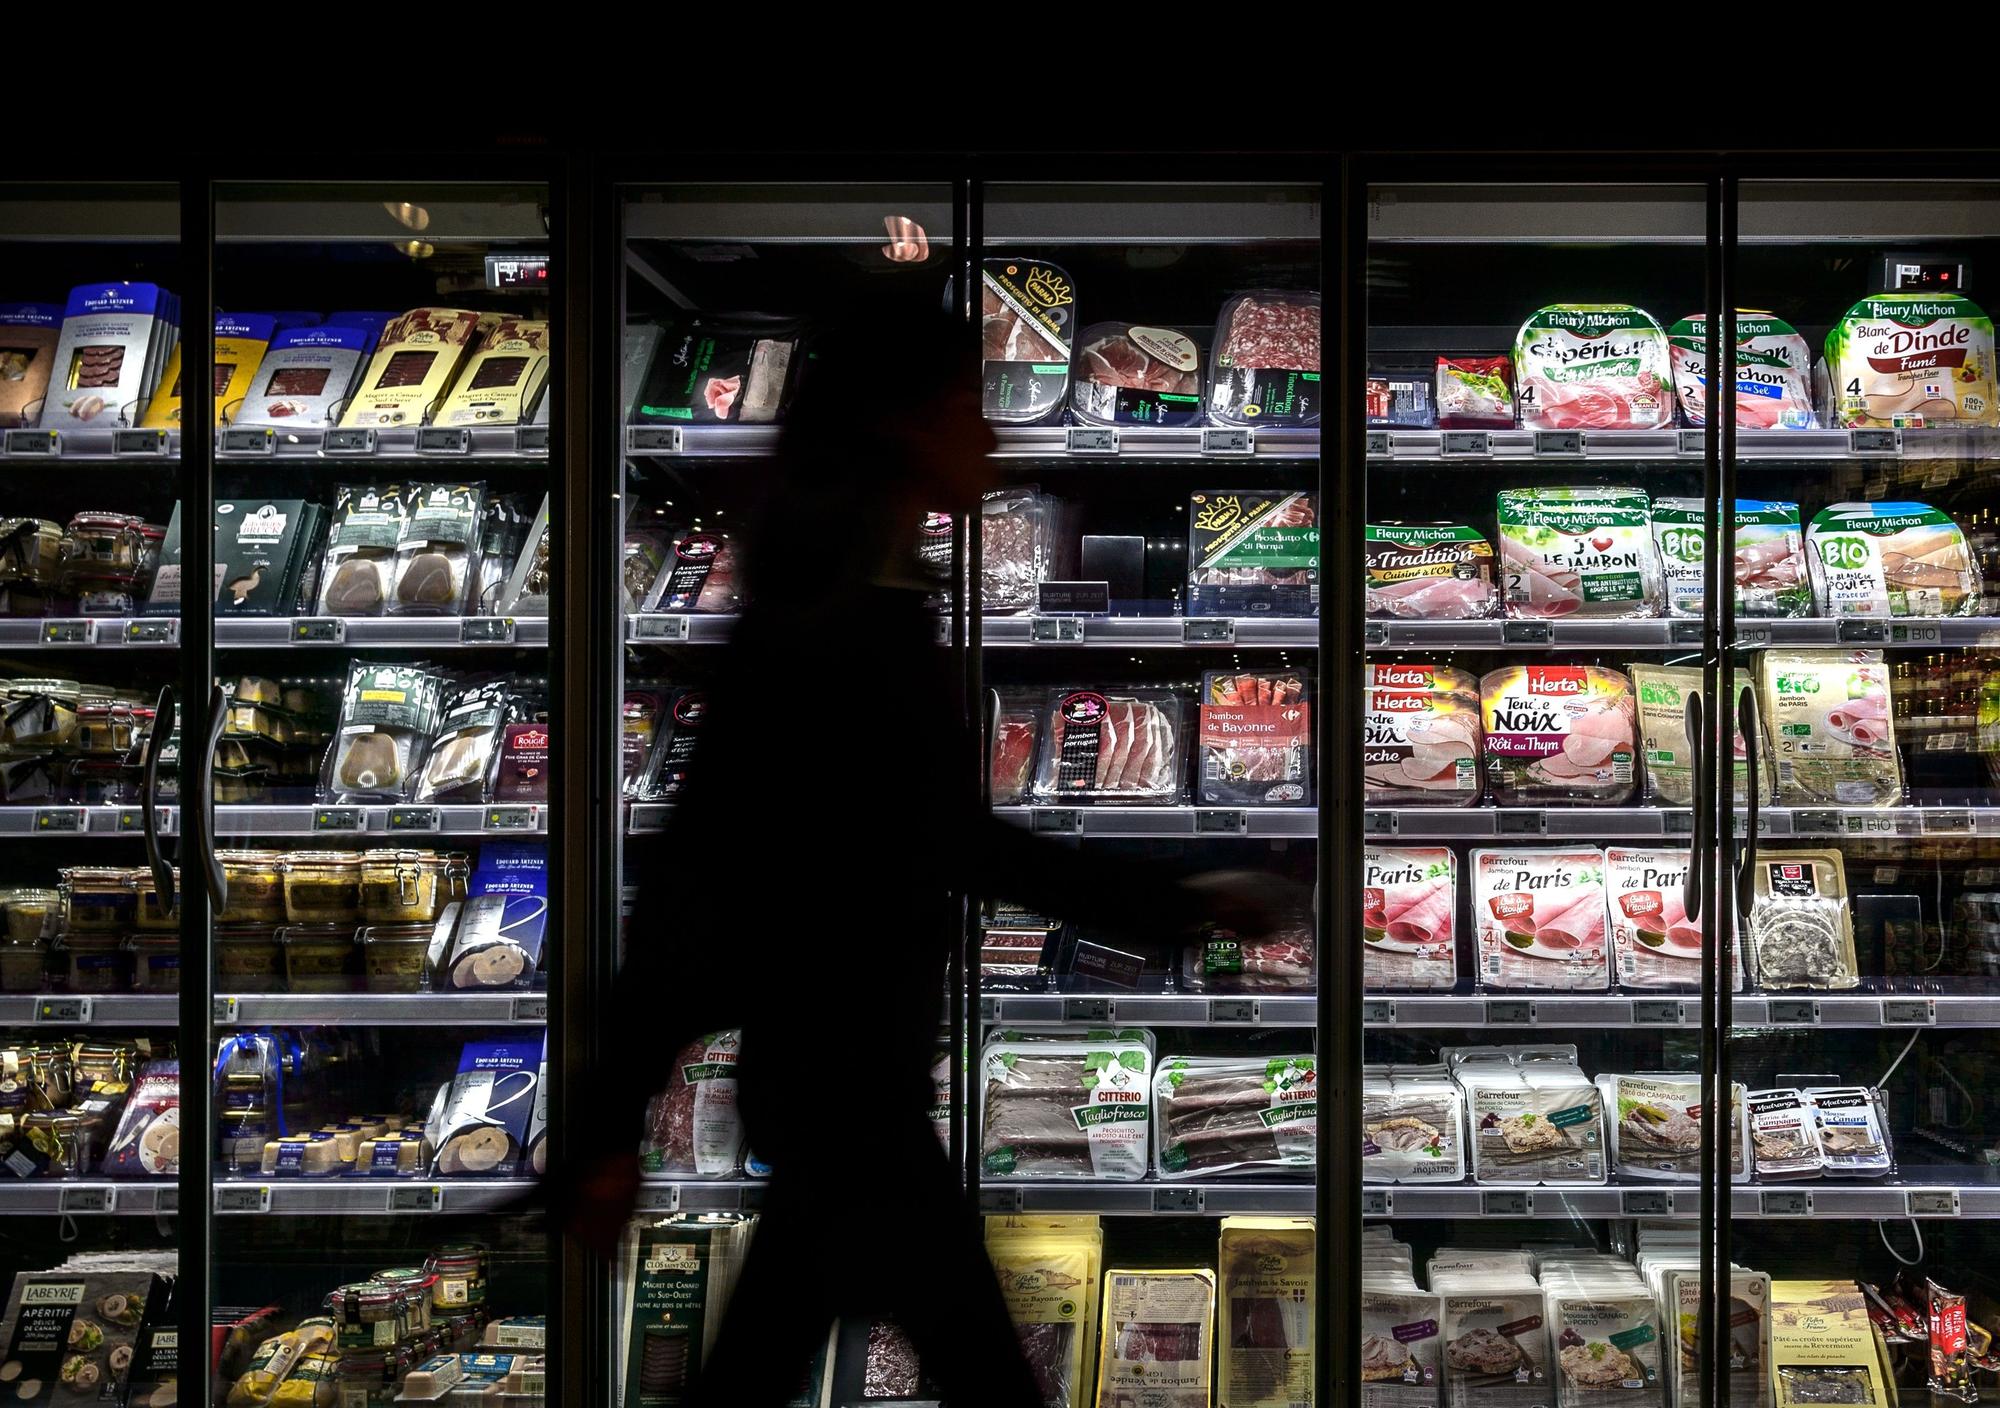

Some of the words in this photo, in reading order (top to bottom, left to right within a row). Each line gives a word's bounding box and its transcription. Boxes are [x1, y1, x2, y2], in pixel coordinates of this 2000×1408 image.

[1030, 281, 1054, 304] PARMA
[999, 275, 1033, 307] PROSCIUTTO
[1039, 310, 1061, 334] PARMA
[1873, 303, 1910, 317] Fleury
[1912, 304, 1955, 315] Michon
[1549, 314, 1584, 329] Fleury
[1587, 315, 1630, 325] Michon
[1857, 326, 1890, 338] Blanc
[1874, 342, 1889, 355] de
[1889, 324, 1970, 354] Dinde
[1900, 355, 1936, 370] Fumé
[1898, 373, 1923, 381] Tranches
[1683, 386, 1695, 398] 2
[1753, 384, 1770, 394] Sel
[1846, 378, 1861, 395] 4
[1520, 386, 1535, 403] 4
[1213, 508, 1237, 528] PARMA
[1533, 514, 1569, 524] Fleury
[1572, 515, 1614, 524] Michon
[1846, 520, 1880, 530] Fleury
[1882, 516, 1922, 527] Michon
[1205, 523, 1241, 552] PROSCIUTTO
[1249, 500, 1271, 518] PARMA
[1254, 533, 1300, 542] Prosciutto
[1376, 529, 1411, 540] Fleury
[1414, 530, 1455, 539] Michon
[1378, 548, 1476, 568] Tradition
[1825, 542, 1866, 564] BIO
[1309, 557, 1317, 566] 6
[1567, 553, 1637, 569] JAMBON
[1383, 572, 1421, 580] Cuisiné
[1430, 566, 1450, 575] l'Os
[1509, 575, 1521, 589] 2
[1918, 590, 1927, 600] 2
[1742, 629, 1766, 640] BIO
[1911, 628, 1935, 640] BIO
[1378, 668, 1424, 684] Herta
[1531, 669, 1578, 692] Herta
[1376, 695, 1422, 709] Herta
[1208, 711, 1243, 720] Jambon
[1493, 710, 1562, 732] Noix
[1208, 723, 1220, 731] de
[1222, 723, 1275, 732] Bayonne
[1064, 738, 1098, 747] portugais
[1290, 737, 1299, 747] 6
[1487, 737, 1512, 750] Rôti
[1525, 738, 1559, 755] Thym
[1783, 741, 1792, 752] 2
[1488, 759, 1502, 770] 4
[1867, 820, 1891, 830] BIO
[1481, 857, 1528, 866] Carrefour
[1610, 853, 1655, 862] Carrefour
[1367, 864, 1423, 886] Paris
[1493, 879, 1510, 890] de
[1515, 868, 1572, 890] Paris
[1622, 877, 1639, 888] de
[1483, 931, 1494, 946] 4
[1616, 928, 1627, 945] 6
[1207, 941, 1238, 950] BIO
[1620, 1080, 1657, 1091] Carrefour
[1098, 1092, 1141, 1102] CITTERIO
[1280, 1091, 1315, 1100] CITTERIO
[1477, 1091, 1520, 1100] Carrefour
[1646, 1092, 1687, 1101] CAMPAGNE
[1755, 1100, 1796, 1111] Madrange
[1821, 1097, 1862, 1107] Madrange
[1081, 1106, 1145, 1124] Tagliofresco
[1832, 1115, 1867, 1123] Canard
[1413, 1166, 1456, 1174] Carrefour
[646, 1260, 664, 1270] CLOS
[679, 1260, 698, 1270] SOZY
[26, 1287, 79, 1300] LABEYRIE
[1448, 1300, 1492, 1308] Carrefour
[23, 1309, 72, 1318] APÉRITIF
[1284, 1349, 1292, 1360] 6
